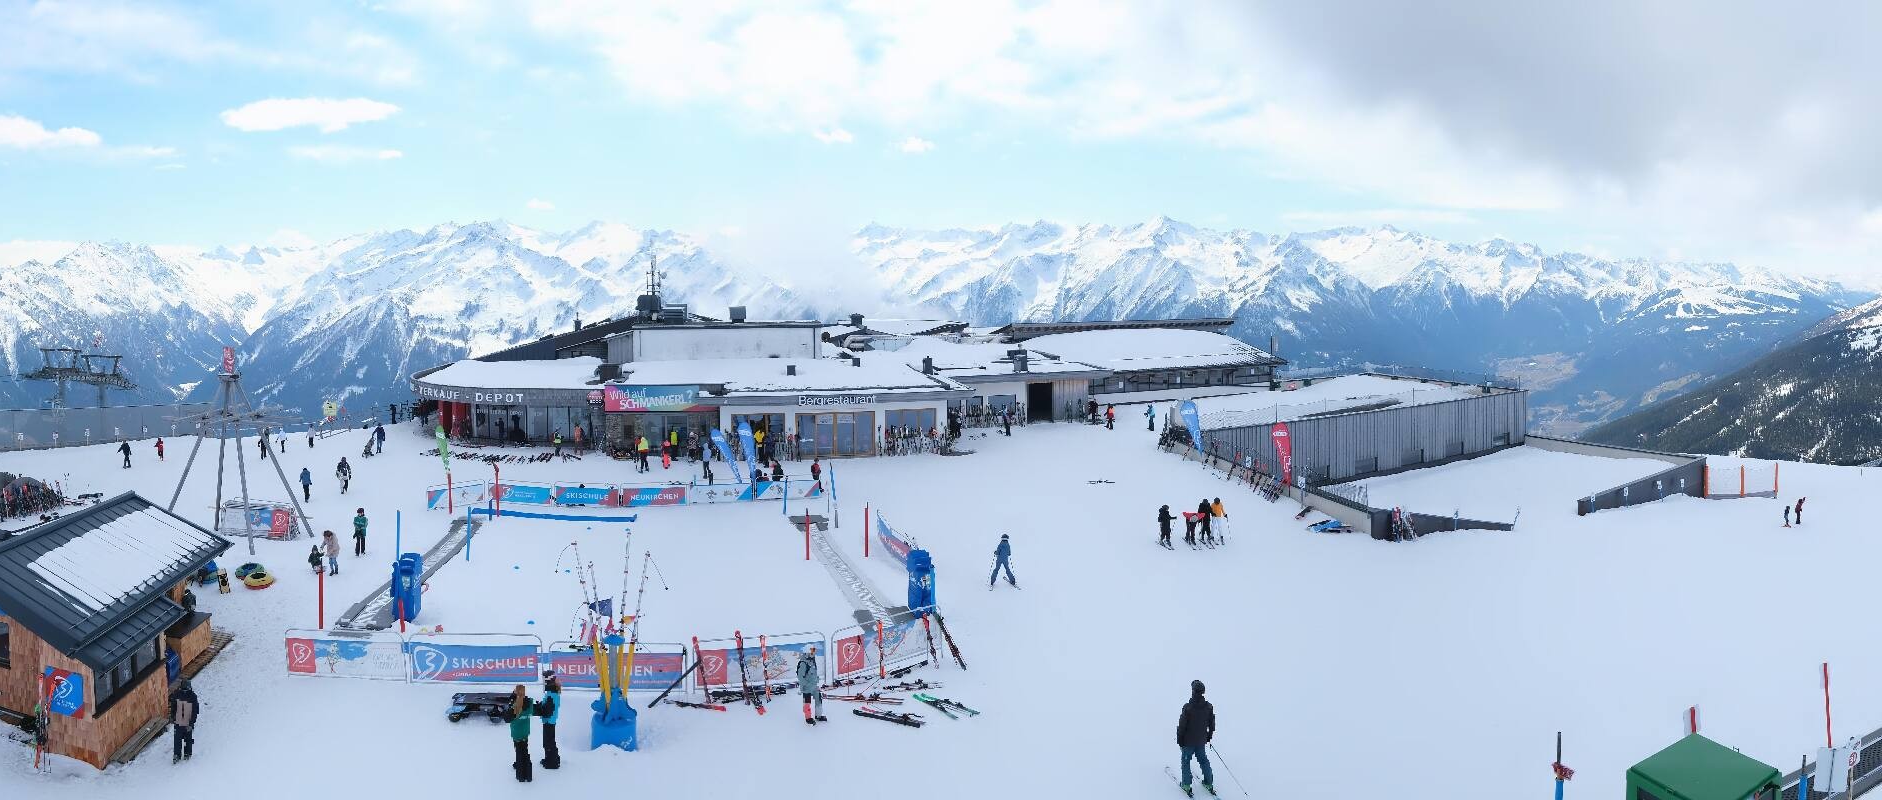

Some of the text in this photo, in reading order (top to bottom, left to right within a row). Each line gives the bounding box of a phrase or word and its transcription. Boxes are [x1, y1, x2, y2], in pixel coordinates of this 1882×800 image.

[475, 393, 524, 403] DEPOT
[610, 388, 646, 400] Wild auf
[798, 395, 876, 406] Bergrestaurant
[566, 492, 609, 500] SKISCHULE
[630, 493, 679, 501] NEUKIRCHEN
[452, 657, 535, 670] SKISCHULE
